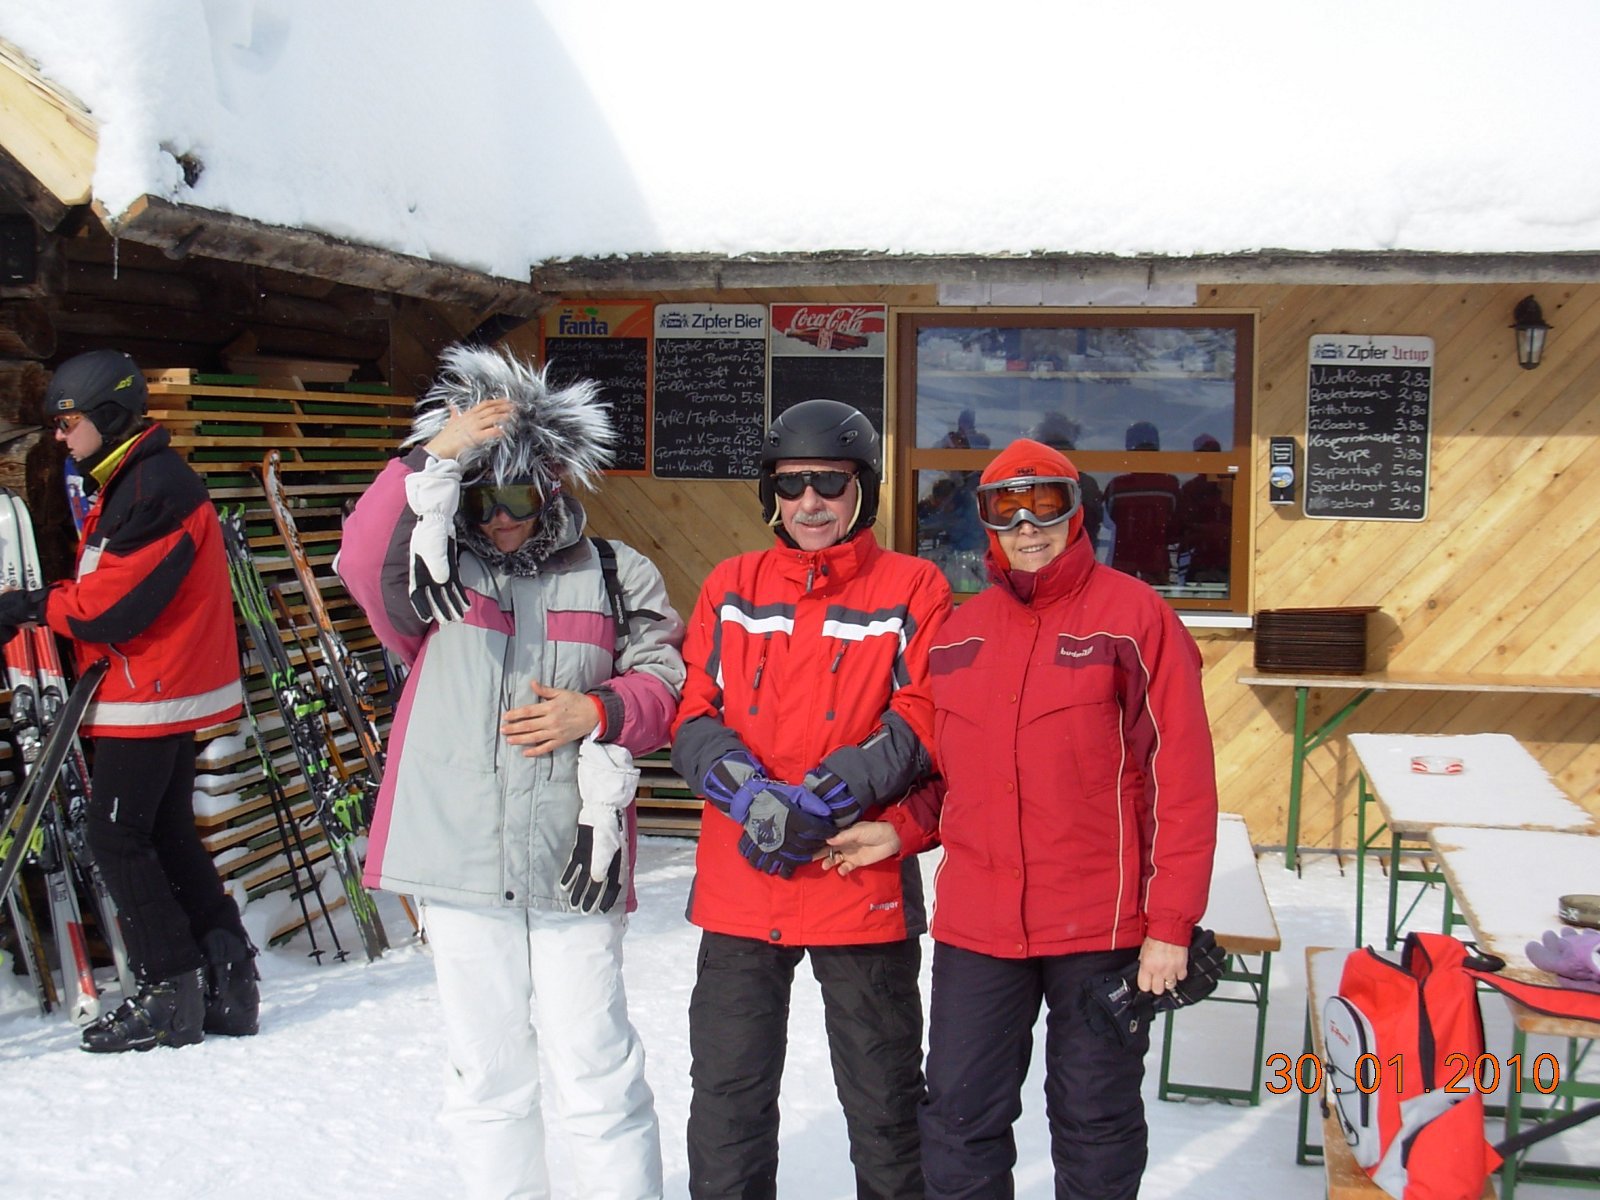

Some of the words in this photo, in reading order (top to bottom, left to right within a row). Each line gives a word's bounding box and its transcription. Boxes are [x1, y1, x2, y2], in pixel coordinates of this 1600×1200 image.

[559, 315, 609, 335] Fanta
[691, 313, 732, 331] Zipfer
[734, 313, 763, 328] Bier
[790, 307, 866, 333] Coca-Cola
[1347, 345, 1388, 361] Zipfer
[1392, 345, 1429, 361] Urtyp
[1328, 446, 1371, 463] Suppe
[1310, 480, 1387, 494] Speckbrot
